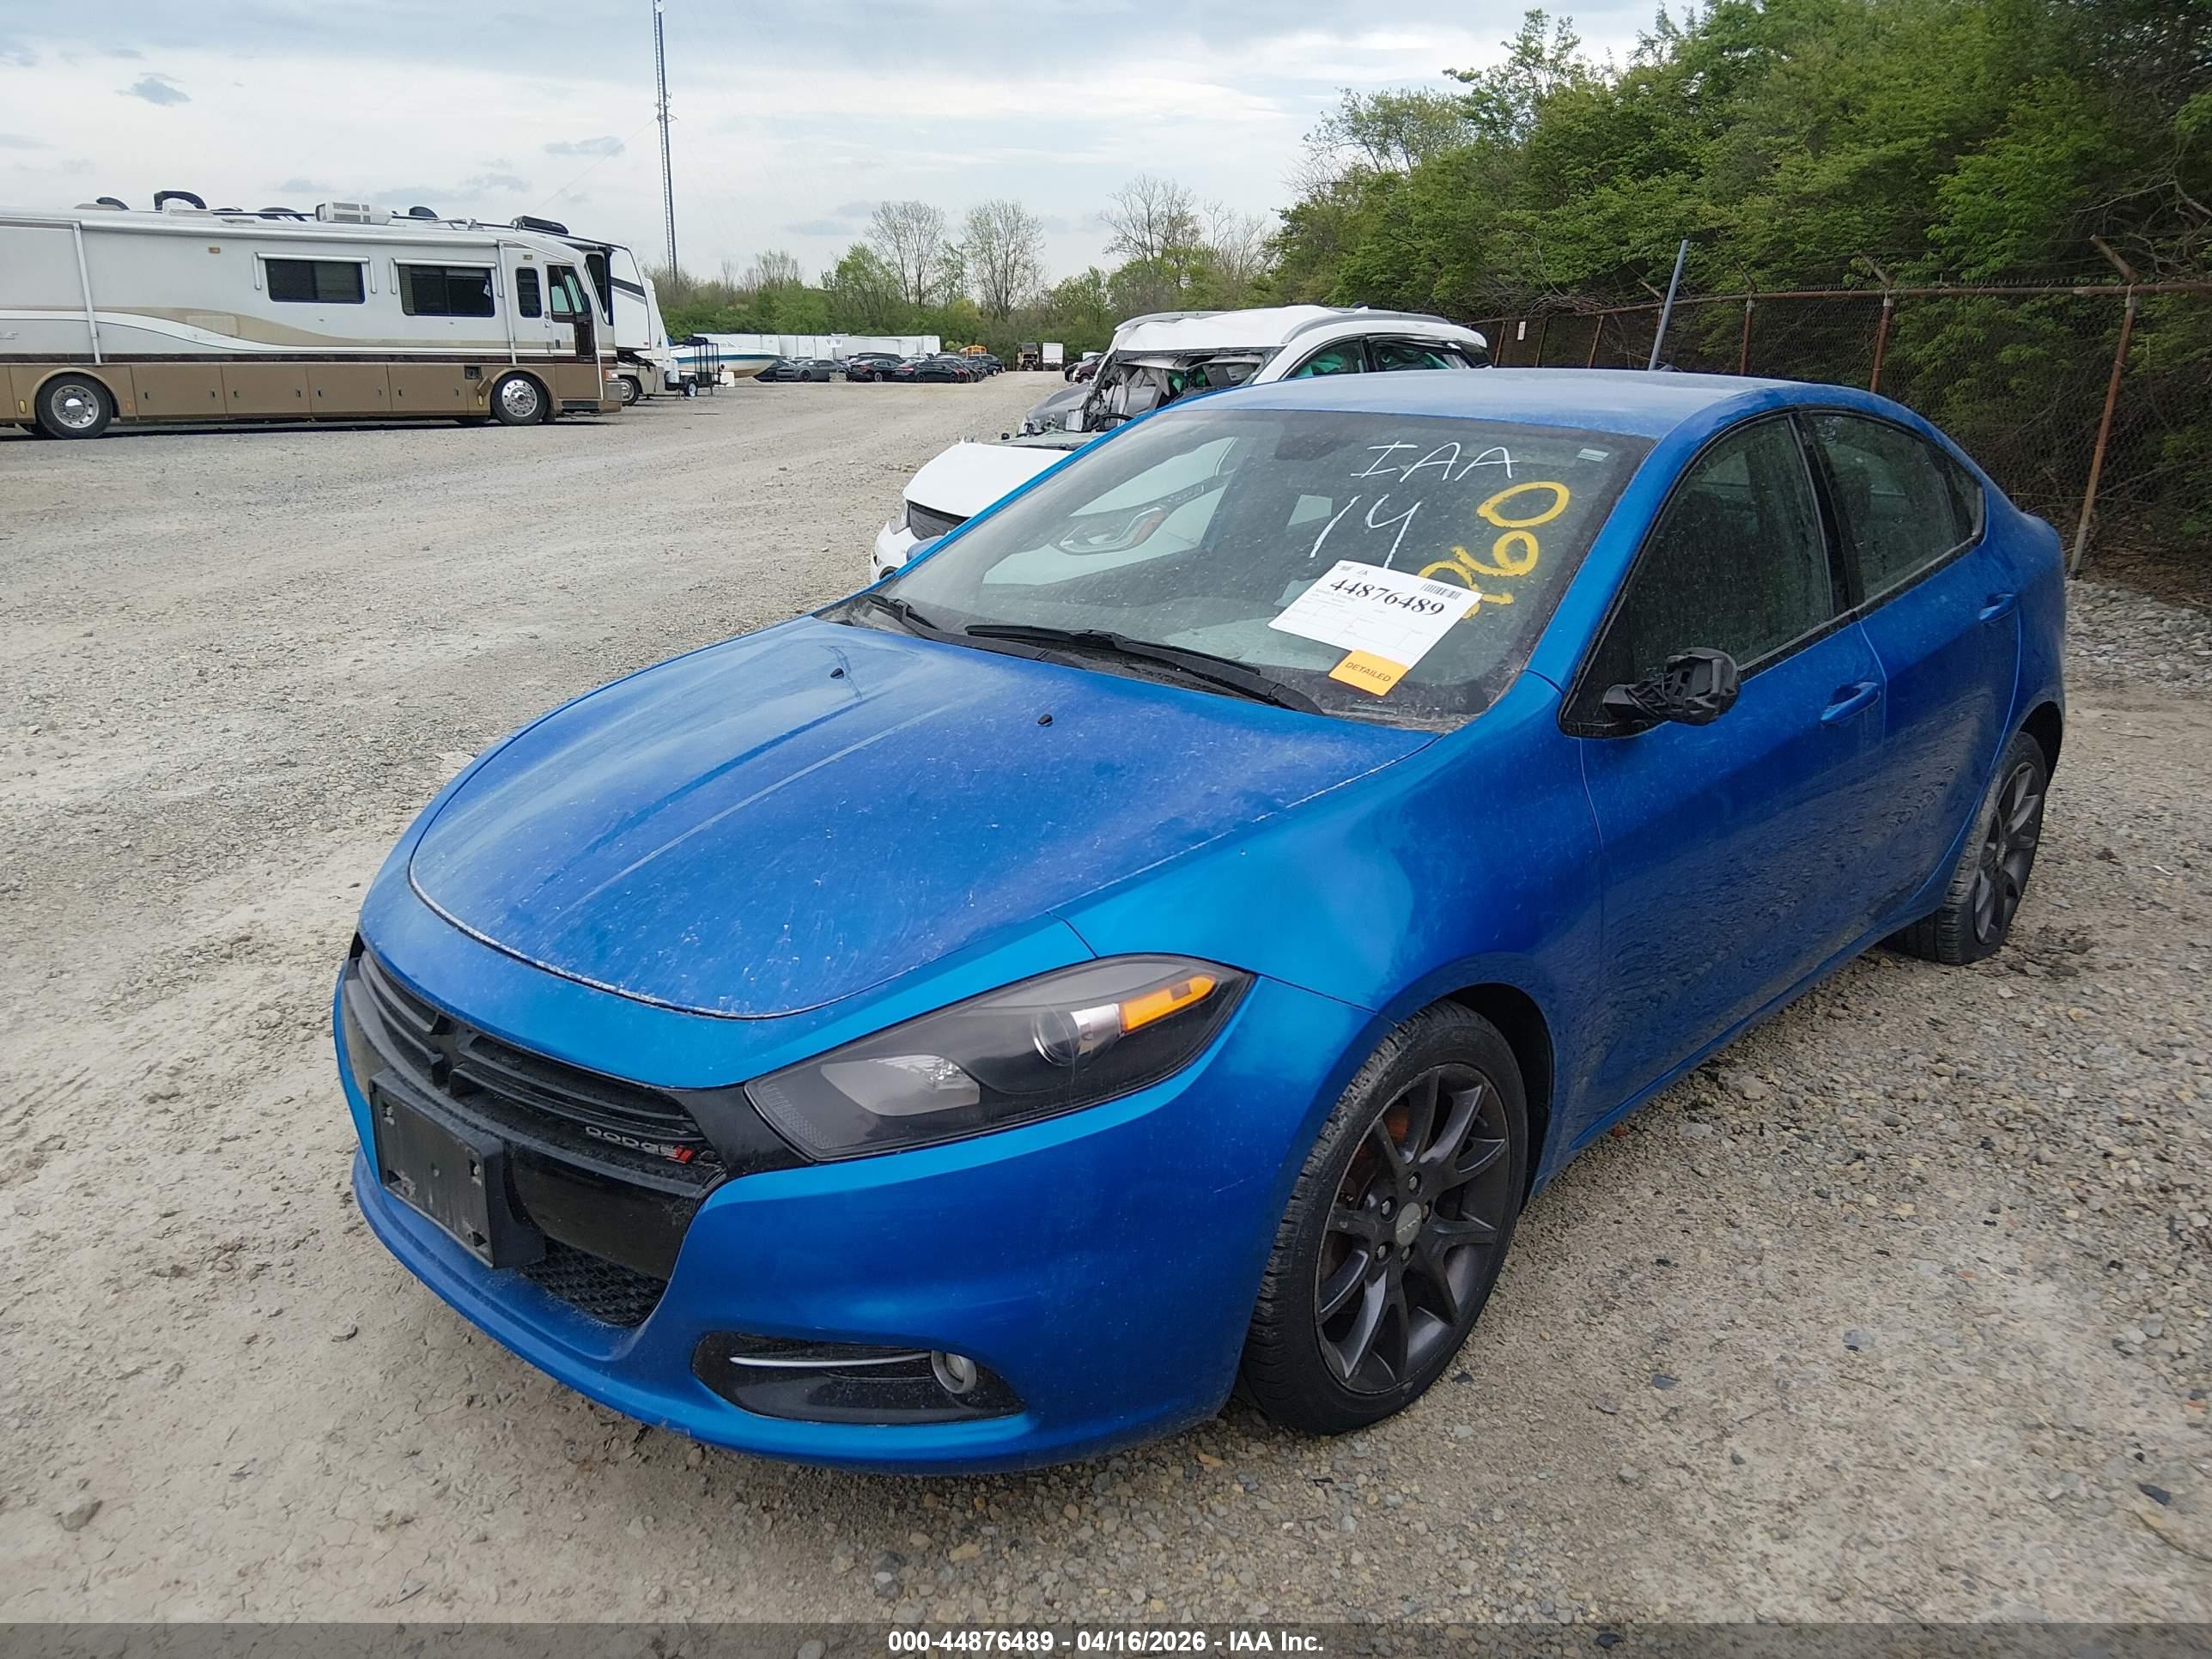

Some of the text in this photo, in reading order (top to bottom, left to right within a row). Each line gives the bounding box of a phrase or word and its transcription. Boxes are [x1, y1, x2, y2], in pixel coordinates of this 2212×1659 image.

[1350, 440, 1520, 483] IAA
[1329, 578, 1445, 617] 44876489
[1345, 661, 1391, 683] DETAILED
[585, 1126, 679, 1158] DODGE
